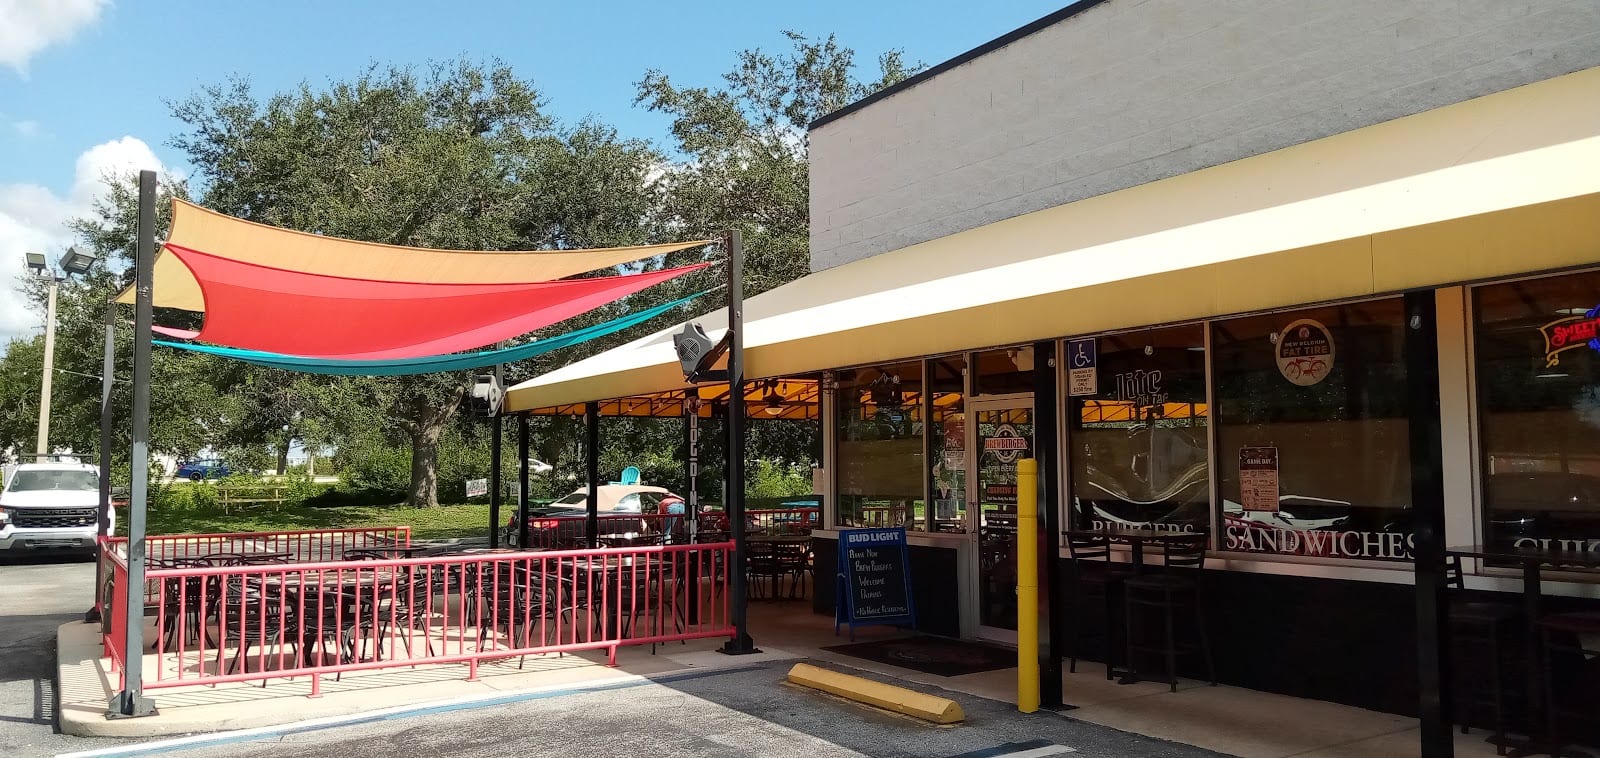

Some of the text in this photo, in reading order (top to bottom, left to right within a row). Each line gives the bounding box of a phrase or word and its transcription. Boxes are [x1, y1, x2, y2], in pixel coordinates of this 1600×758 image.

[1551, 320, 1600, 347] SWEET
[1283, 345, 1328, 356] FAT TIRE
[1152, 393, 1169, 405] TAP
[848, 532, 899, 542] BUD LIGHT
